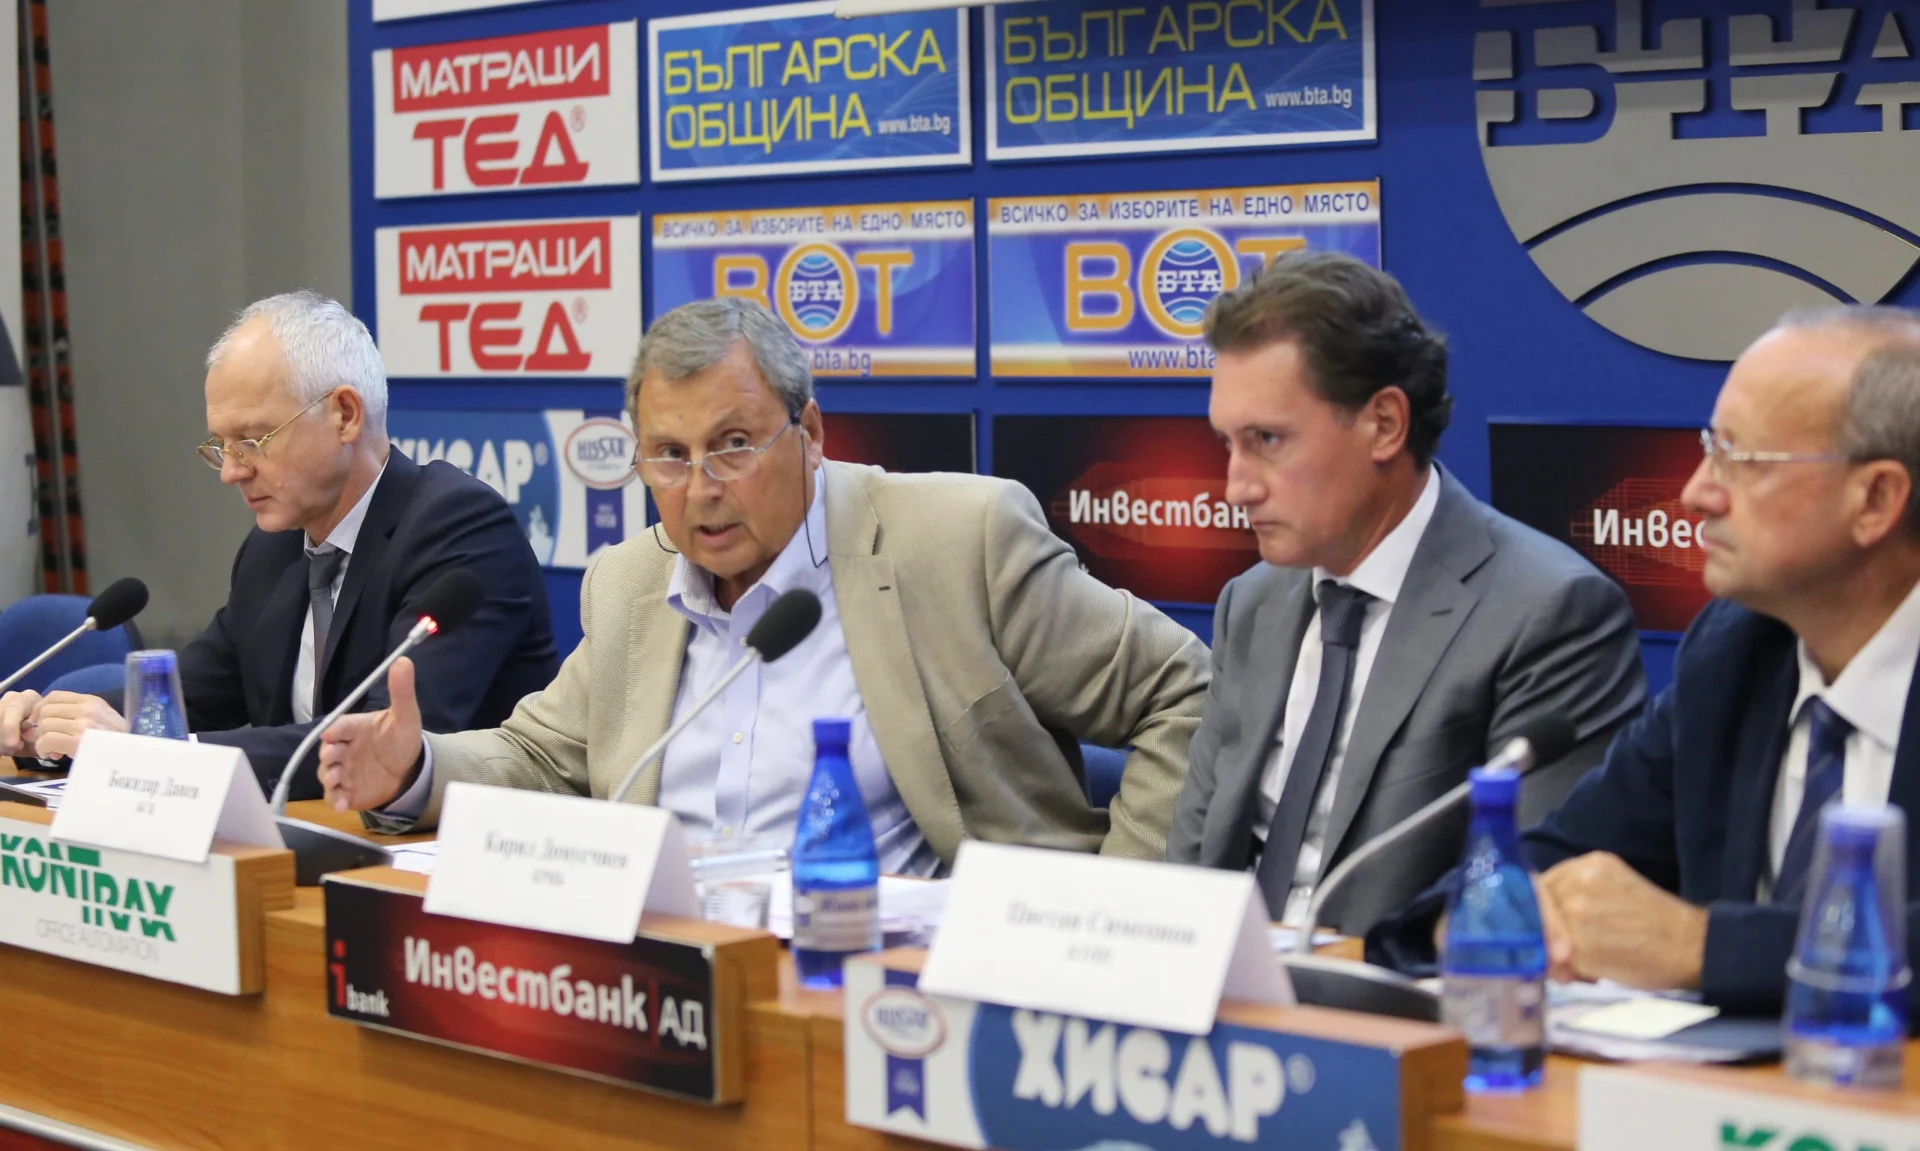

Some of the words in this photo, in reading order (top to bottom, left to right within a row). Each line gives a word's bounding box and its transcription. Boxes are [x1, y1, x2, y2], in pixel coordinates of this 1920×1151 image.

[1004, 0, 1348, 64] БЪЛГАРСКА
[400, 42, 600, 99] МАТРАЦИ
[664, 28, 946, 96] БЪЛГАРСКА
[665, 93, 871, 154] ОБЩИНА
[878, 113, 951, 137] www.bta.bg
[1005, 63, 1257, 129] ОБЩИНА
[1265, 85, 1353, 109] www.bta.bg
[663, 219, 718, 239] ВСИЧКО
[725, 218, 743, 236] ЗА
[750, 215, 825, 236] ИЗБОРИТЕ
[833, 214, 853, 231] НА
[860, 212, 903, 233] ЕДНО
[911, 210, 966, 229] МЯСТО
[1001, 205, 1069, 225] ВСИЧКО
[1078, 203, 1100, 222] ЗА
[1109, 198, 1199, 220] ИЗБОРИТЕ
[1210, 197, 1233, 217] НА
[1244, 195, 1293, 219] ЕДНО
[1304, 192, 1370, 214] МЯСТО
[405, 237, 603, 283] МАТРАЦИ
[1157, 269, 1223, 294] БТА
[789, 279, 844, 302] БТА
[0, 833, 177, 943] KONTRAX
[346, 984, 389, 1017] bank
[404, 936, 648, 1033] Инвестбанк
[658, 995, 707, 1050] АД
